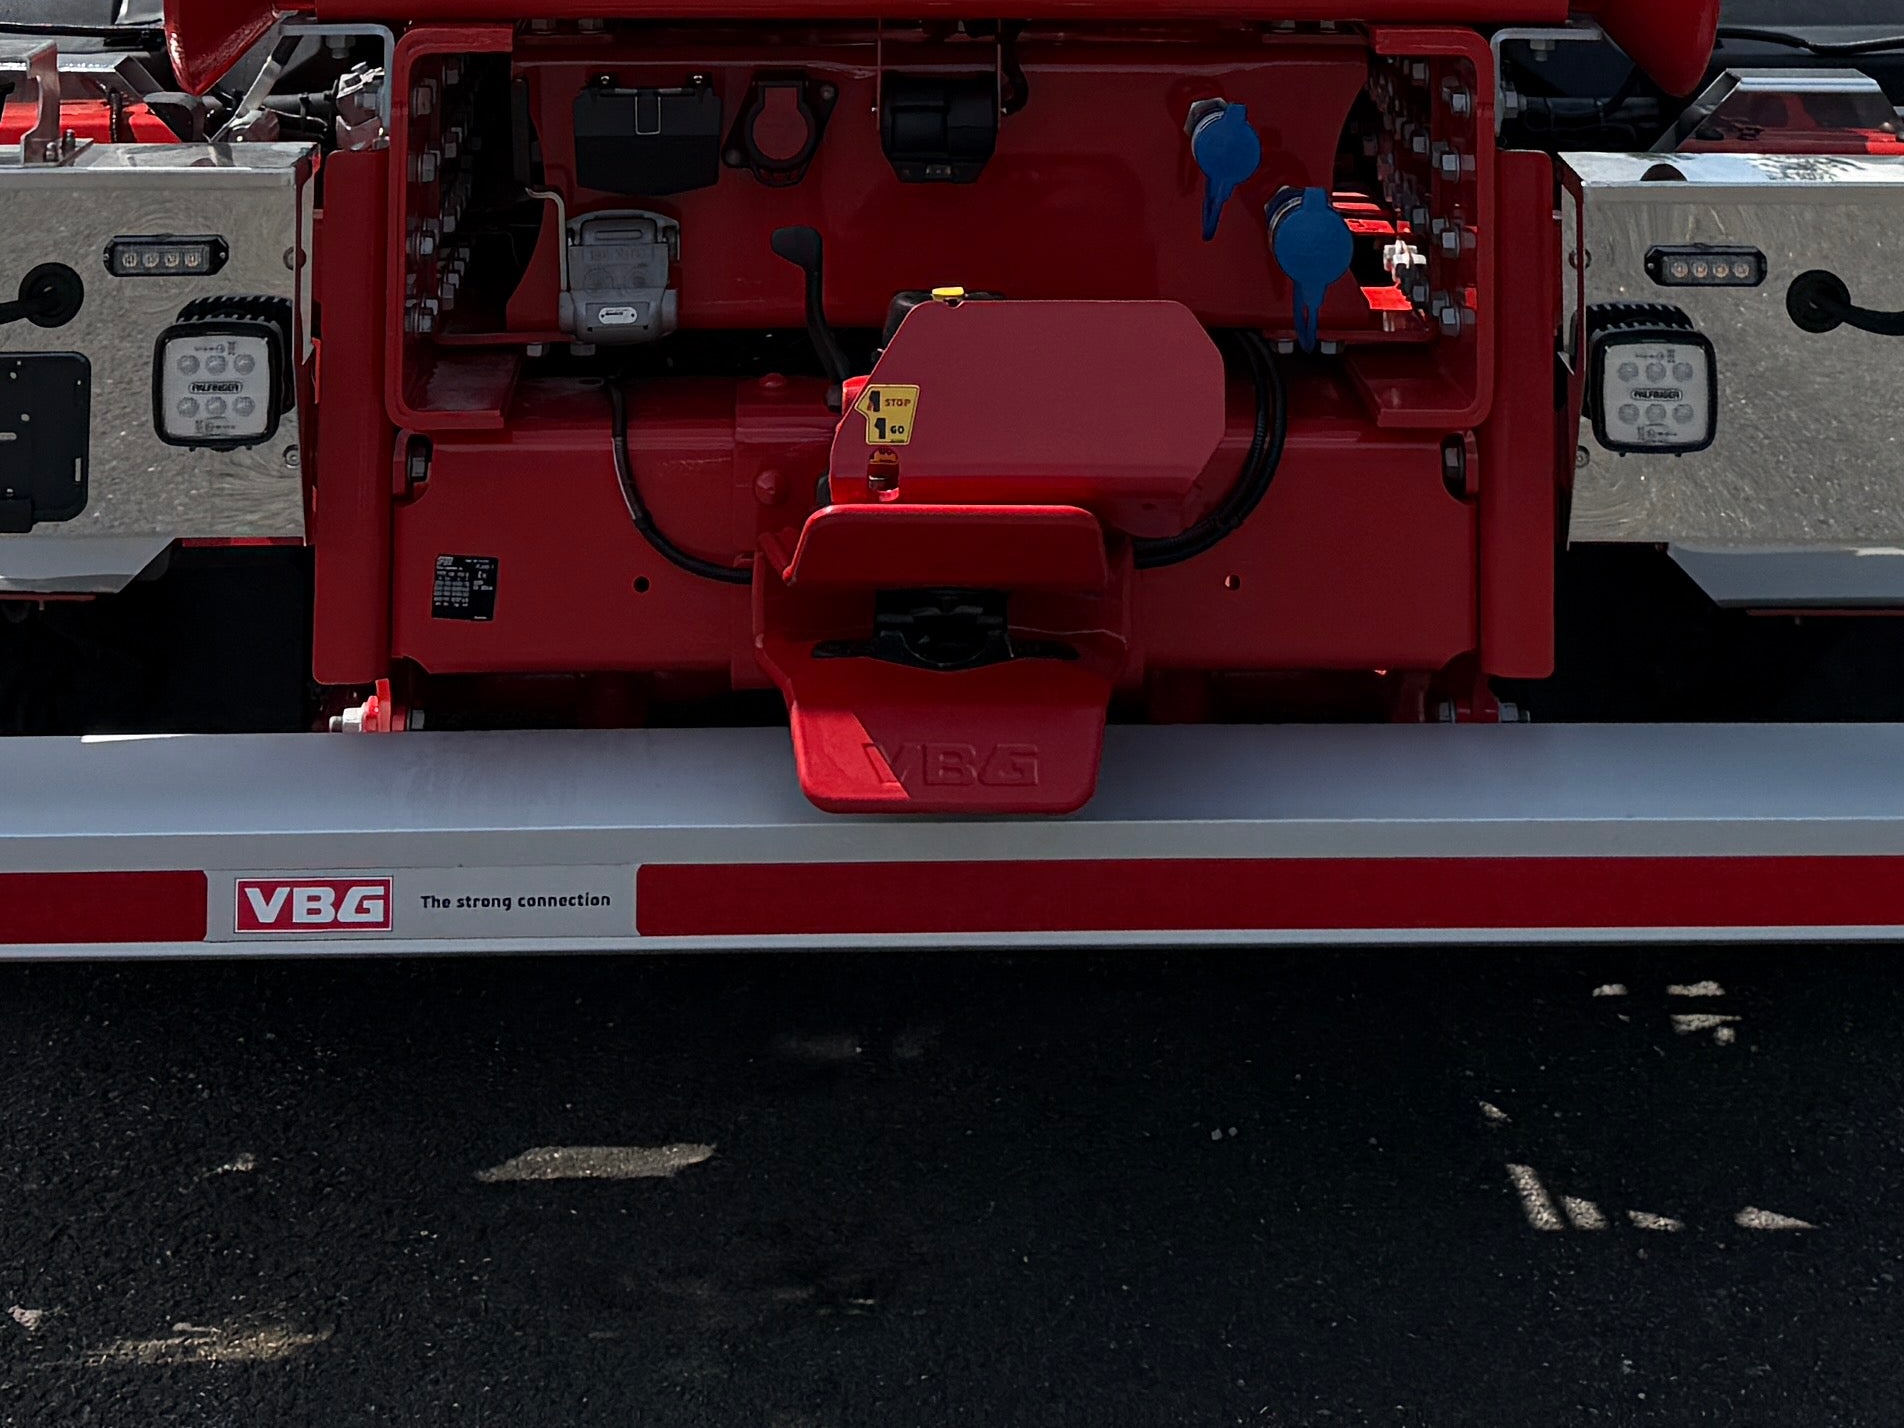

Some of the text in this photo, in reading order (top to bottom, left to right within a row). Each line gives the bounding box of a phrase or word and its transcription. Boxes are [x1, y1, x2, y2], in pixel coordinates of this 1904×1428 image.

[884, 398, 911, 407] STOP
[890, 425, 905, 434] GO
[862, 743, 1039, 786] VBG
[244, 886, 385, 923] VBG
[420, 892, 611, 911] The strong connection
